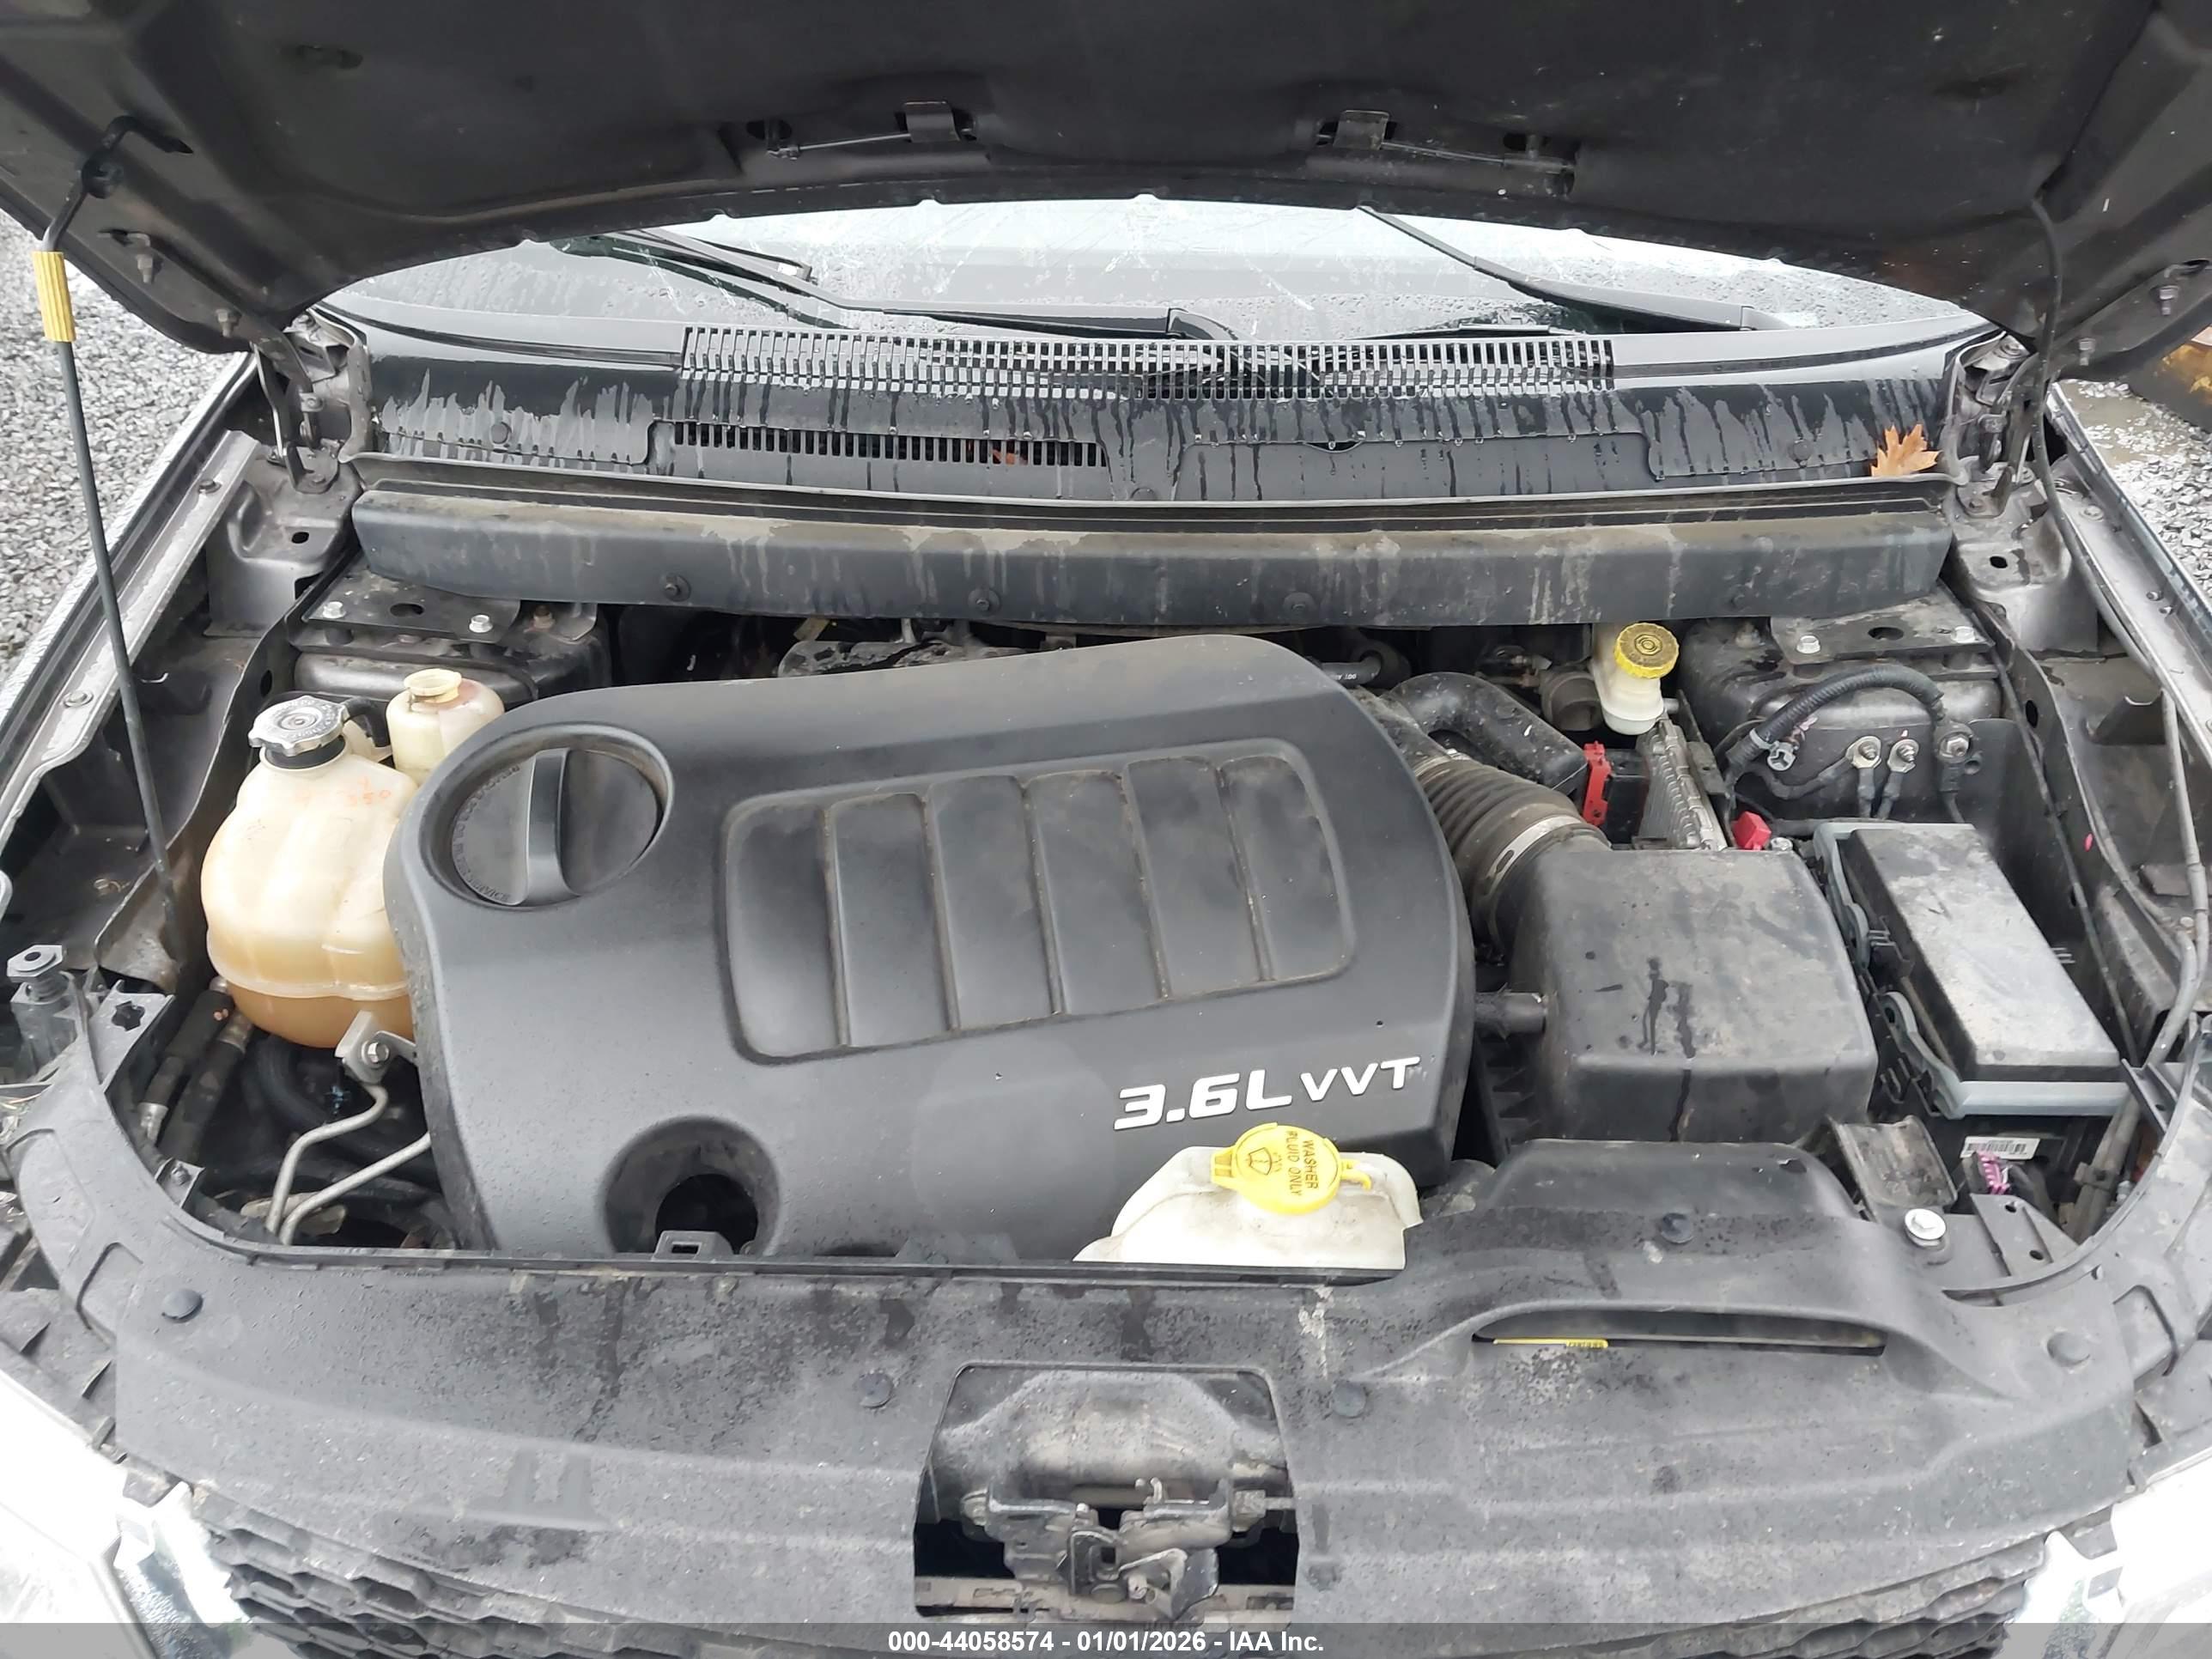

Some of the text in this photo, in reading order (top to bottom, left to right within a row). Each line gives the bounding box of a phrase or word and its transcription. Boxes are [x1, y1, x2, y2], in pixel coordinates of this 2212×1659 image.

[1113, 1056, 1421, 1131] 3.6L VVT
[1285, 1130, 1303, 1197] FLUID ONLY
[1303, 1139, 1319, 1190] WASHER
